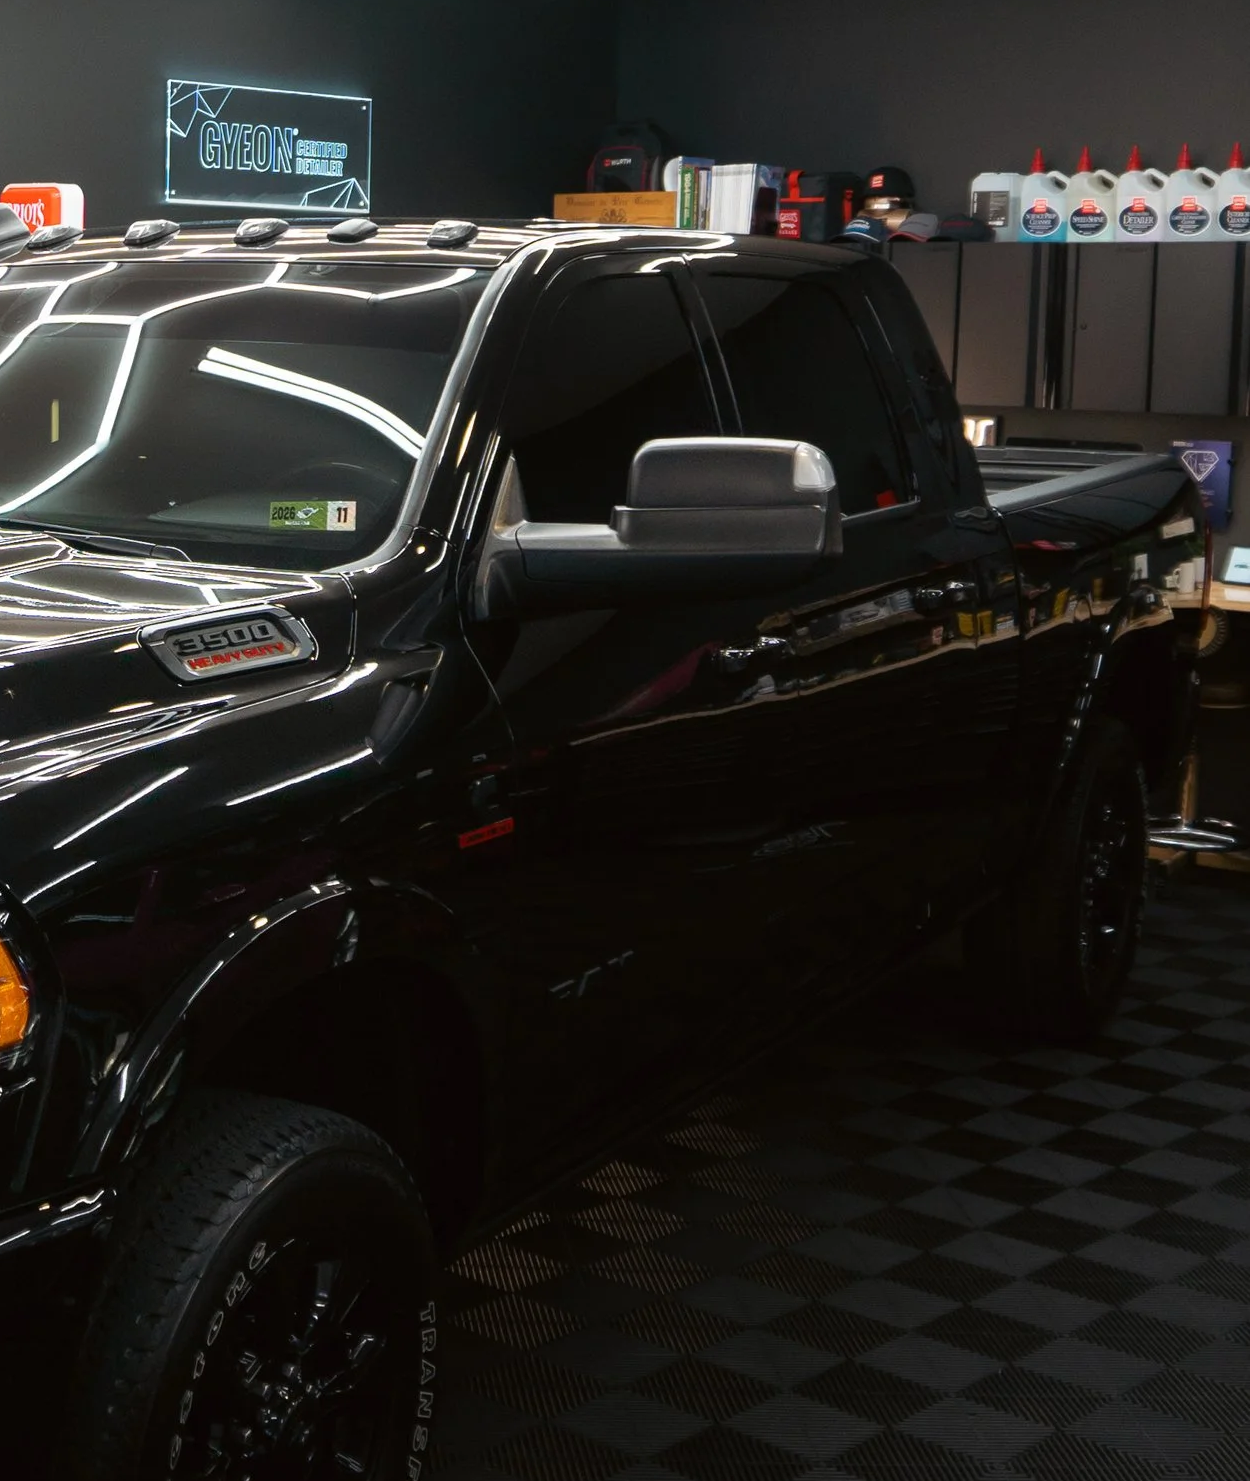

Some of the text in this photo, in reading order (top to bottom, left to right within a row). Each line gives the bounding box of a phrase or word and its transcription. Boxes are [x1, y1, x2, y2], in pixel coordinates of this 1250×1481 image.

[200, 120, 294, 173] GYEON
[296, 139, 348, 159] CERTIFIED
[295, 157, 344, 177] DETAILER
[8, 199, 45, 228] RIOT'S
[271, 506, 348, 523] 2026 11
[173, 623, 273, 655] 3500
[187, 642, 286, 670] HEAVY DUTY
